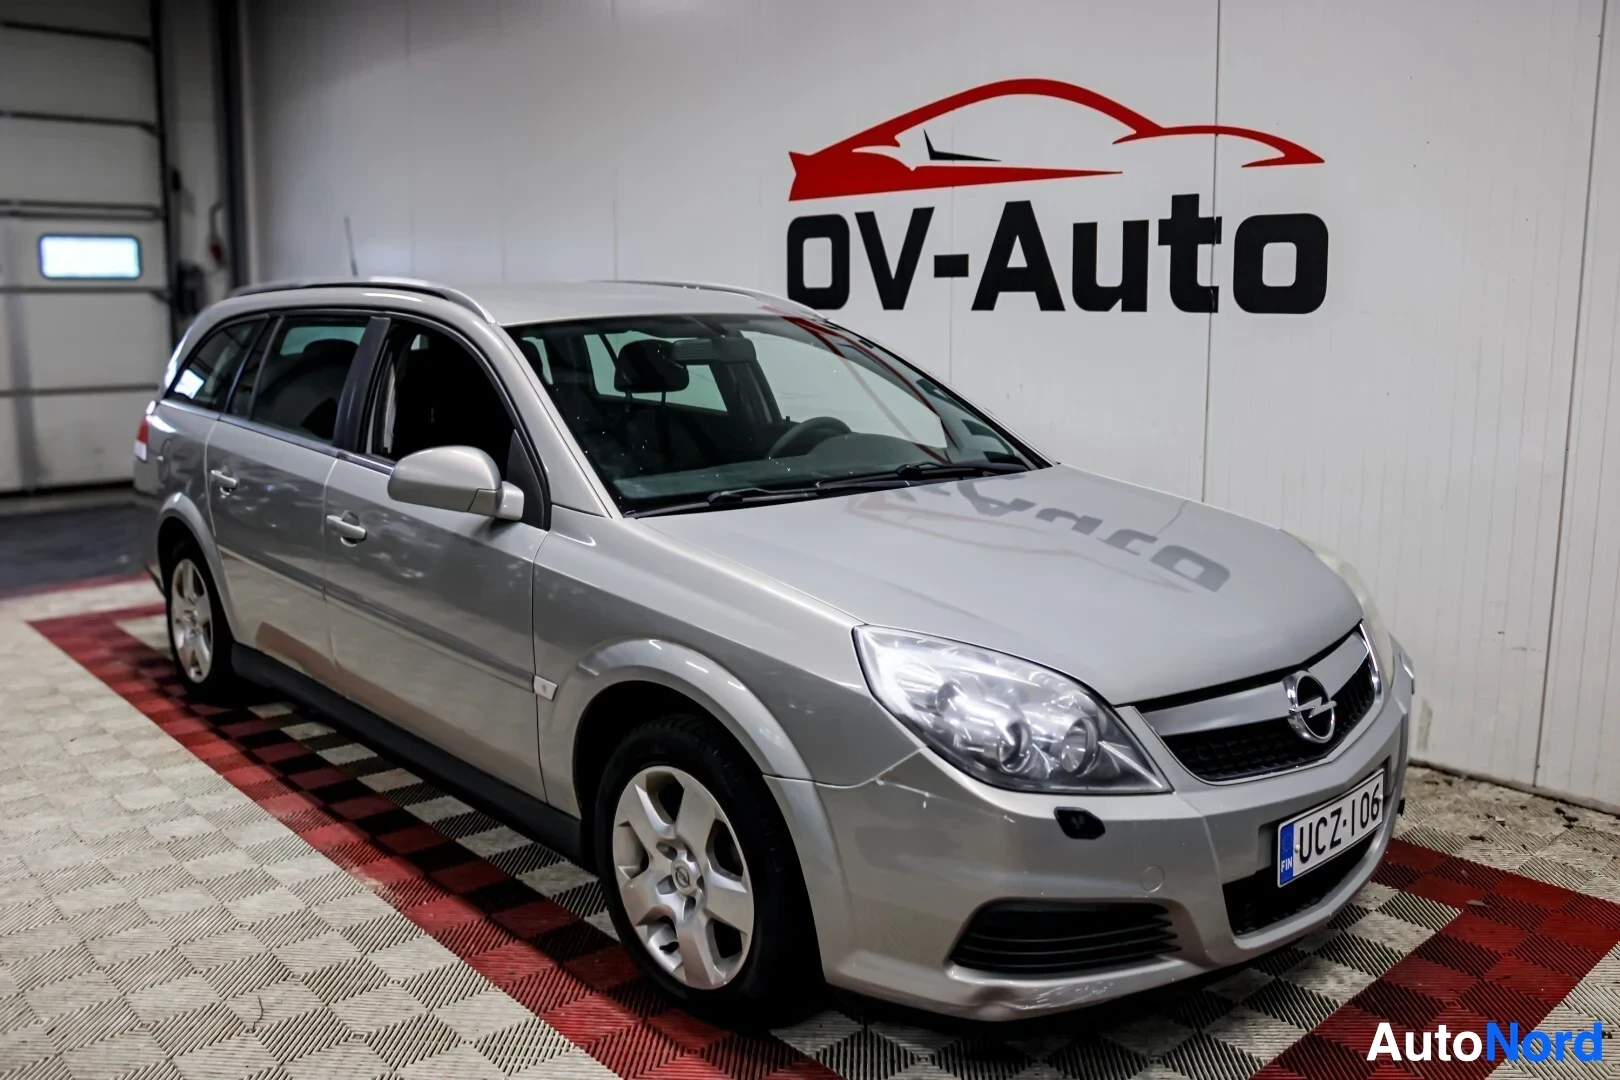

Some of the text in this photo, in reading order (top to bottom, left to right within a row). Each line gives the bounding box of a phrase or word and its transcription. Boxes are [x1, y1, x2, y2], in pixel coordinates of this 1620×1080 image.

[786, 193, 1329, 314] OV-Auto
[1299, 782, 1381, 864] UCZ-106
[1280, 856, 1293, 873] FIN
